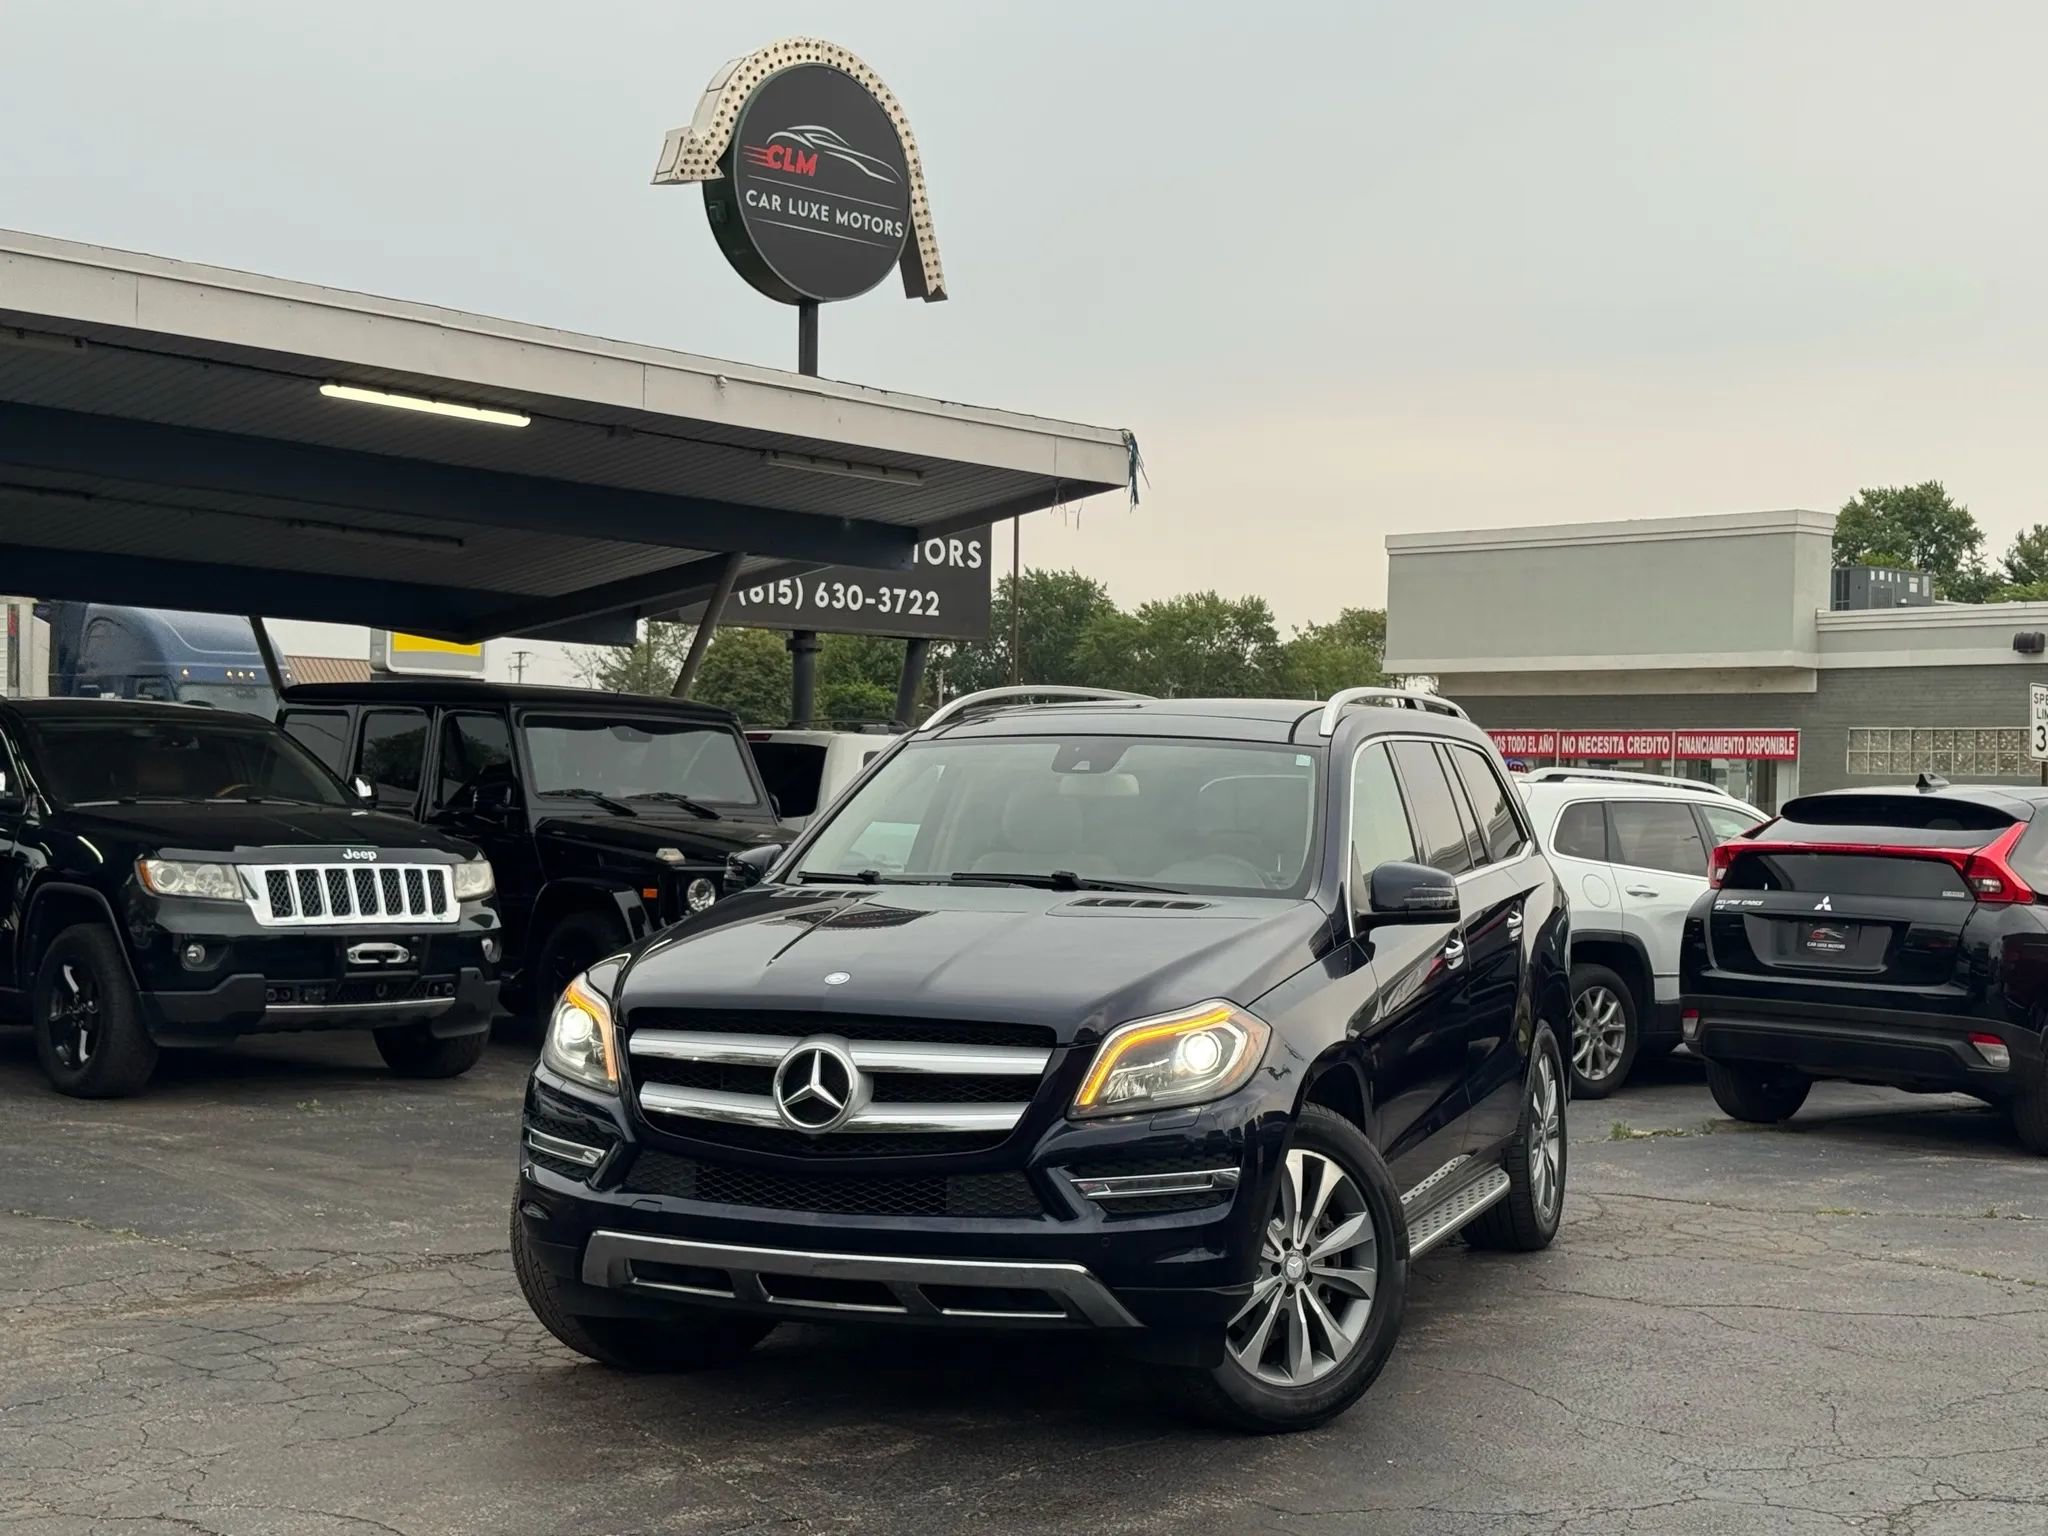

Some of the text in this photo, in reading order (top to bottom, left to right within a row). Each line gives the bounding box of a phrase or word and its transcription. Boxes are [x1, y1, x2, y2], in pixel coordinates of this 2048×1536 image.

[766, 144, 818, 177] CLM
[745, 189, 904, 238] CAR LUXE MOTORS
[815, 581, 940, 617] 630-3722
[1507, 735, 1527, 753] TODO
[1528, 735, 1537, 753] EL
[1538, 734, 1554, 753] AÑO
[1562, 735, 1670, 754] NO NECESITA CREDITO
[1677, 735, 1795, 755] FINANCIAMIENTO DISPONIBLE
[2035, 725, 2047, 752] 3
[342, 848, 377, 861] Jeep
